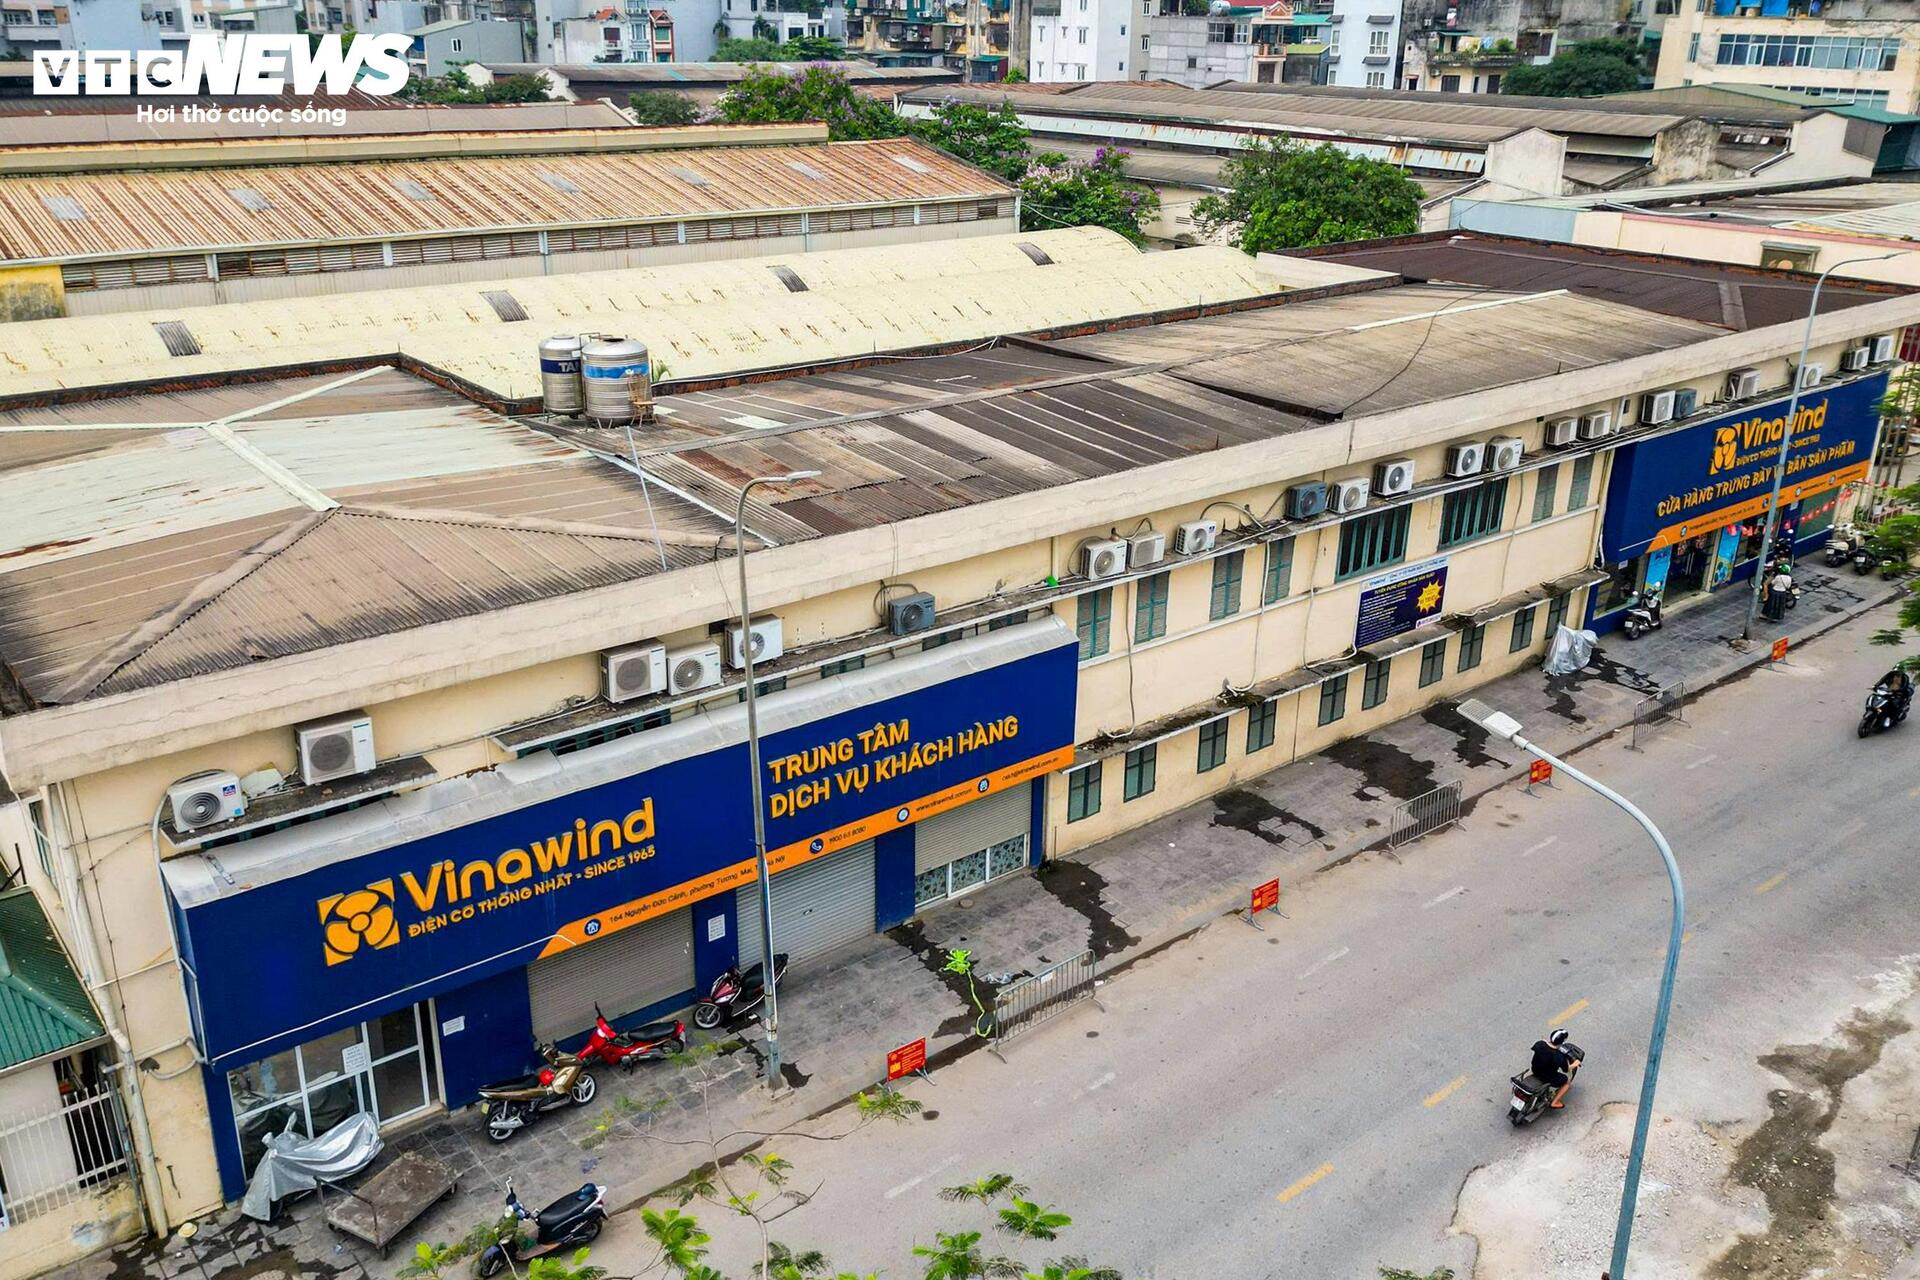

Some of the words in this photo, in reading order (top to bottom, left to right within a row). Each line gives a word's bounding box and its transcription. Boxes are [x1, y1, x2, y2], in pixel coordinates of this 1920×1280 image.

[1657, 494, 1681, 518] CỬA
[1683, 486, 1714, 509] HÀNG
[1715, 474, 1751, 498] TRUNG
[1752, 465, 1772, 487] BÀY
[1786, 454, 1807, 476] BÁN
[1807, 447, 1829, 468] SẢN
[1828, 439, 1856, 463] PHẨM
[768, 738, 854, 784] TRUNG
[857, 719, 910, 755] TÂM
[769, 776, 831, 819] DỊCH
[835, 763, 870, 793] VỤ
[875, 735, 954, 783] KHÁCH
[958, 715, 1019, 754] HÀNG
[401, 797, 656, 912] Vinawind
[408, 913, 448, 939] ĐIỆN
[449, 904, 475, 923] CƠ
[478, 886, 533, 915] THỐNG
[535, 870, 574, 899] NHẤT
[583, 858, 627, 881] SINCE
[626, 845, 656, 867] 1965
[609, 913, 624, 923] 164
[624, 904, 652, 918] Nguyễn
